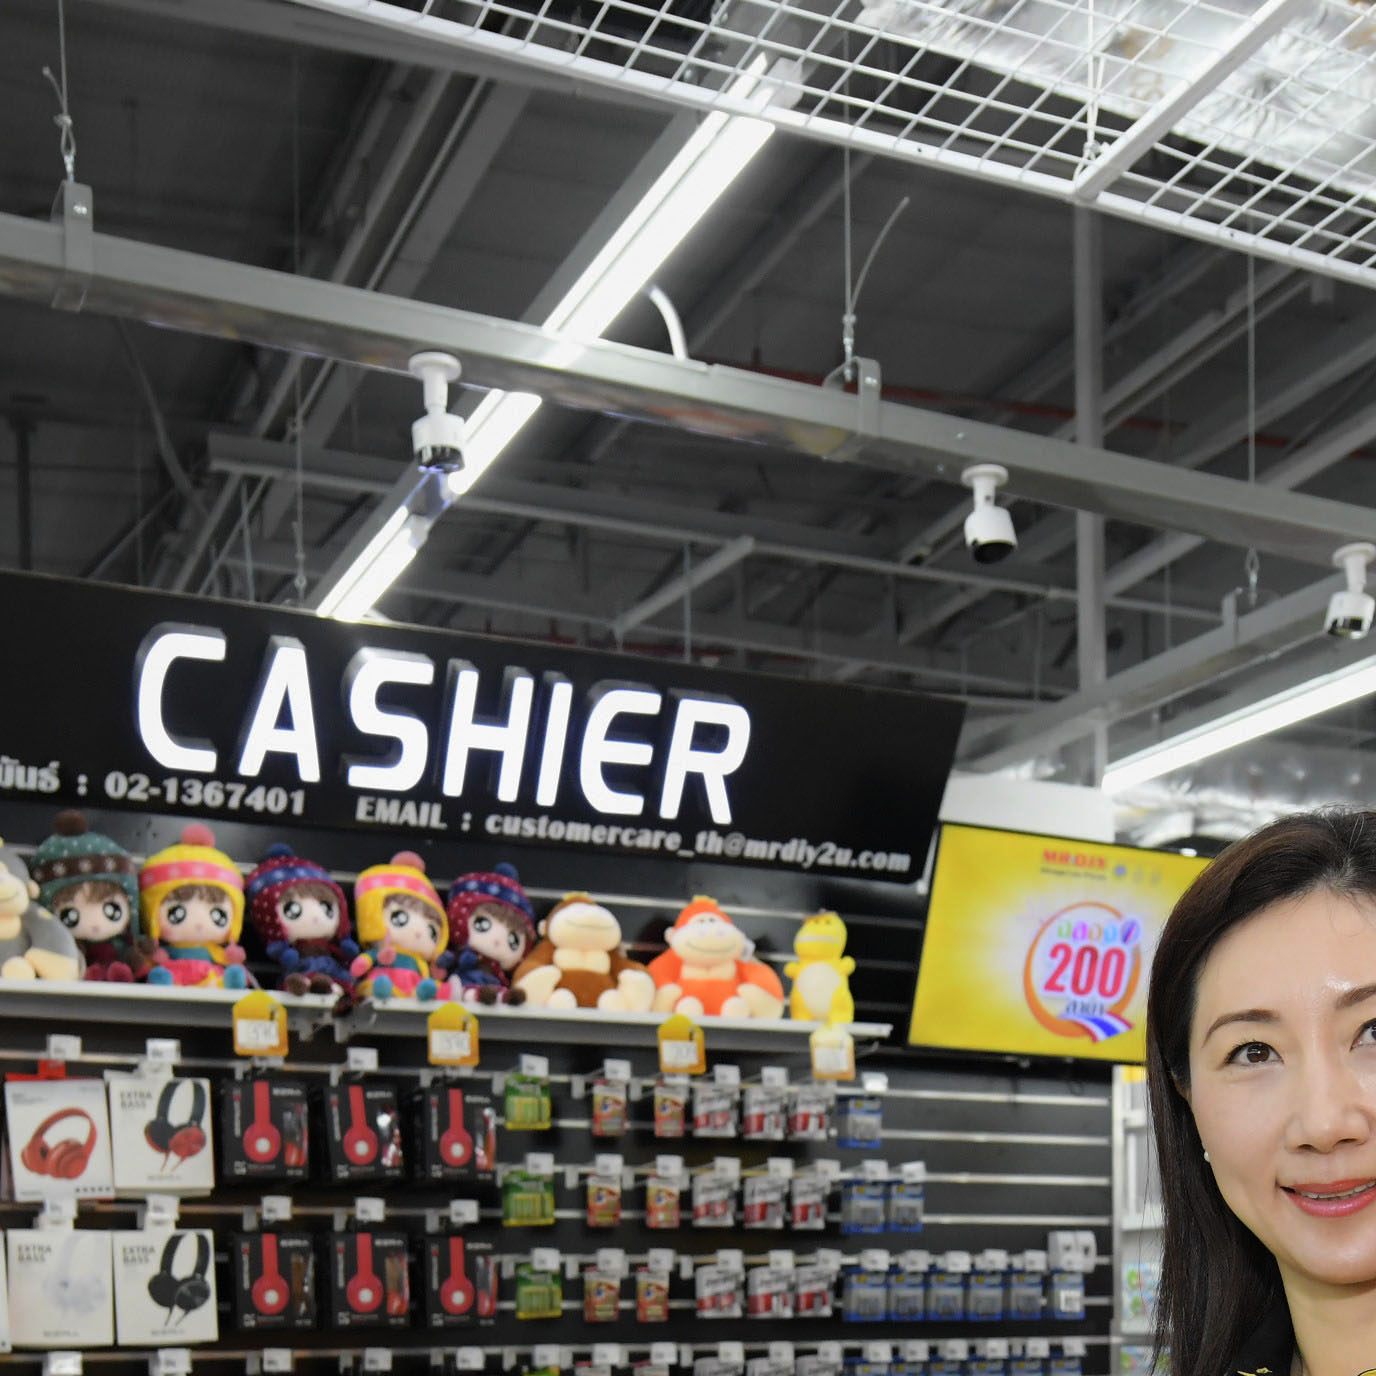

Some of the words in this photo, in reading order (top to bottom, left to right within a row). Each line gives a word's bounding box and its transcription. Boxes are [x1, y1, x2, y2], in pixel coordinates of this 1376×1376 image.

[135, 630, 752, 826] CASHIER
[104, 770, 306, 815] 02-1367401
[355, 797, 448, 830] EMAIL
[485, 812, 911, 873] customercare_th@mrdiy2u.com
[1044, 941, 1127, 998] 200
